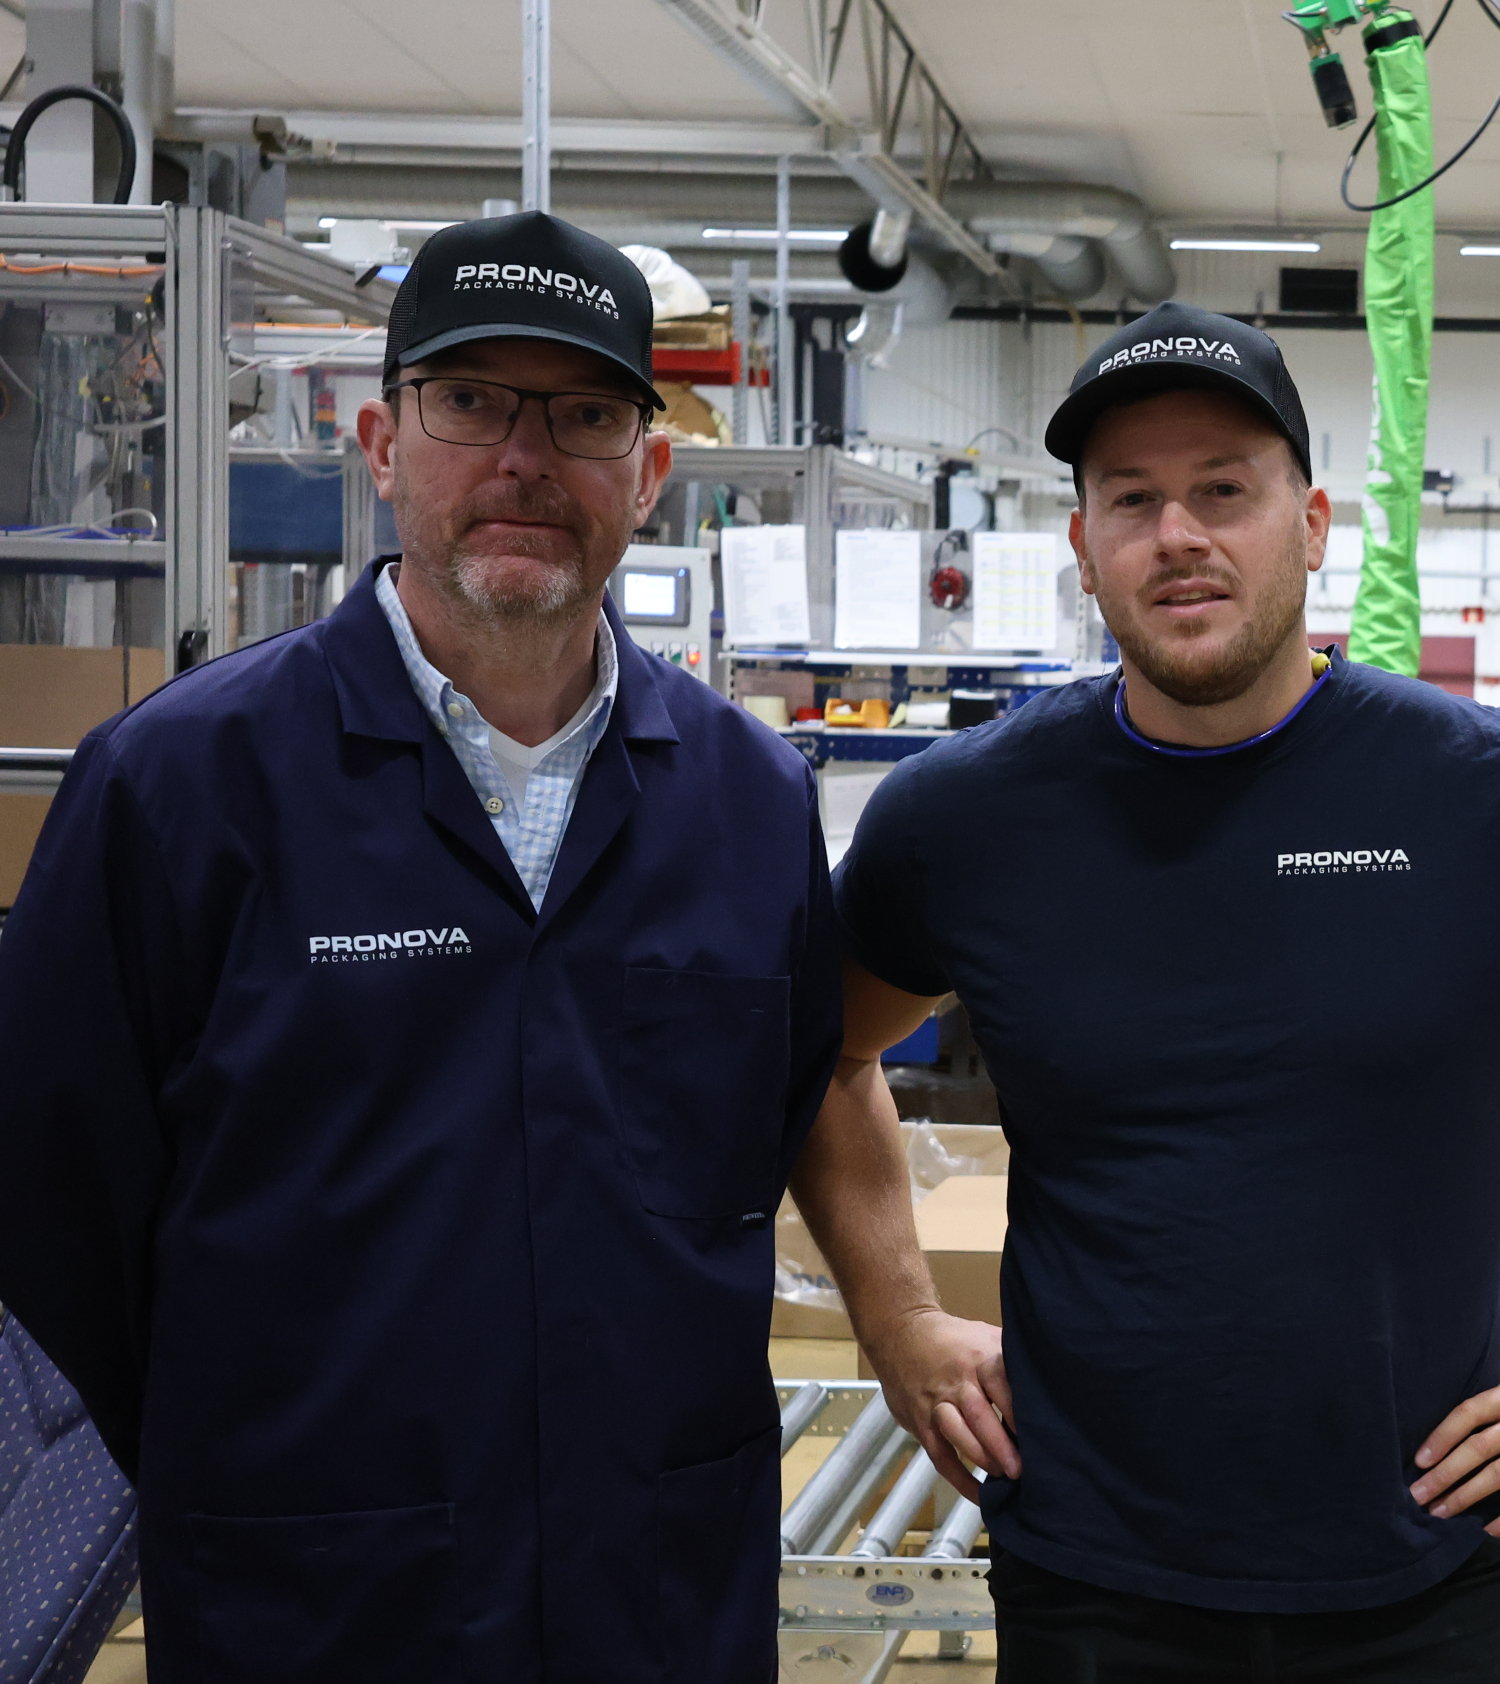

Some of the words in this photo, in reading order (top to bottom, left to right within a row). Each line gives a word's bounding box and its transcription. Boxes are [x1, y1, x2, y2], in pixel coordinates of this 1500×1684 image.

[455, 263, 617, 309] PRONOVA
[453, 281, 546, 294] PACKAGING
[556, 289, 620, 320] SYSTEMS
[1098, 337, 1240, 375] PRONOVA
[1177, 350, 1242, 366] SYSTEMS
[1277, 849, 1410, 869] PRONOVA
[1277, 866, 1349, 876] PACKAGING
[1355, 863, 1412, 872] SYSTEMS
[309, 927, 470, 954] PRONOVA
[310, 951, 398, 964] PACKAGING
[407, 945, 472, 957] SYSTEMS
